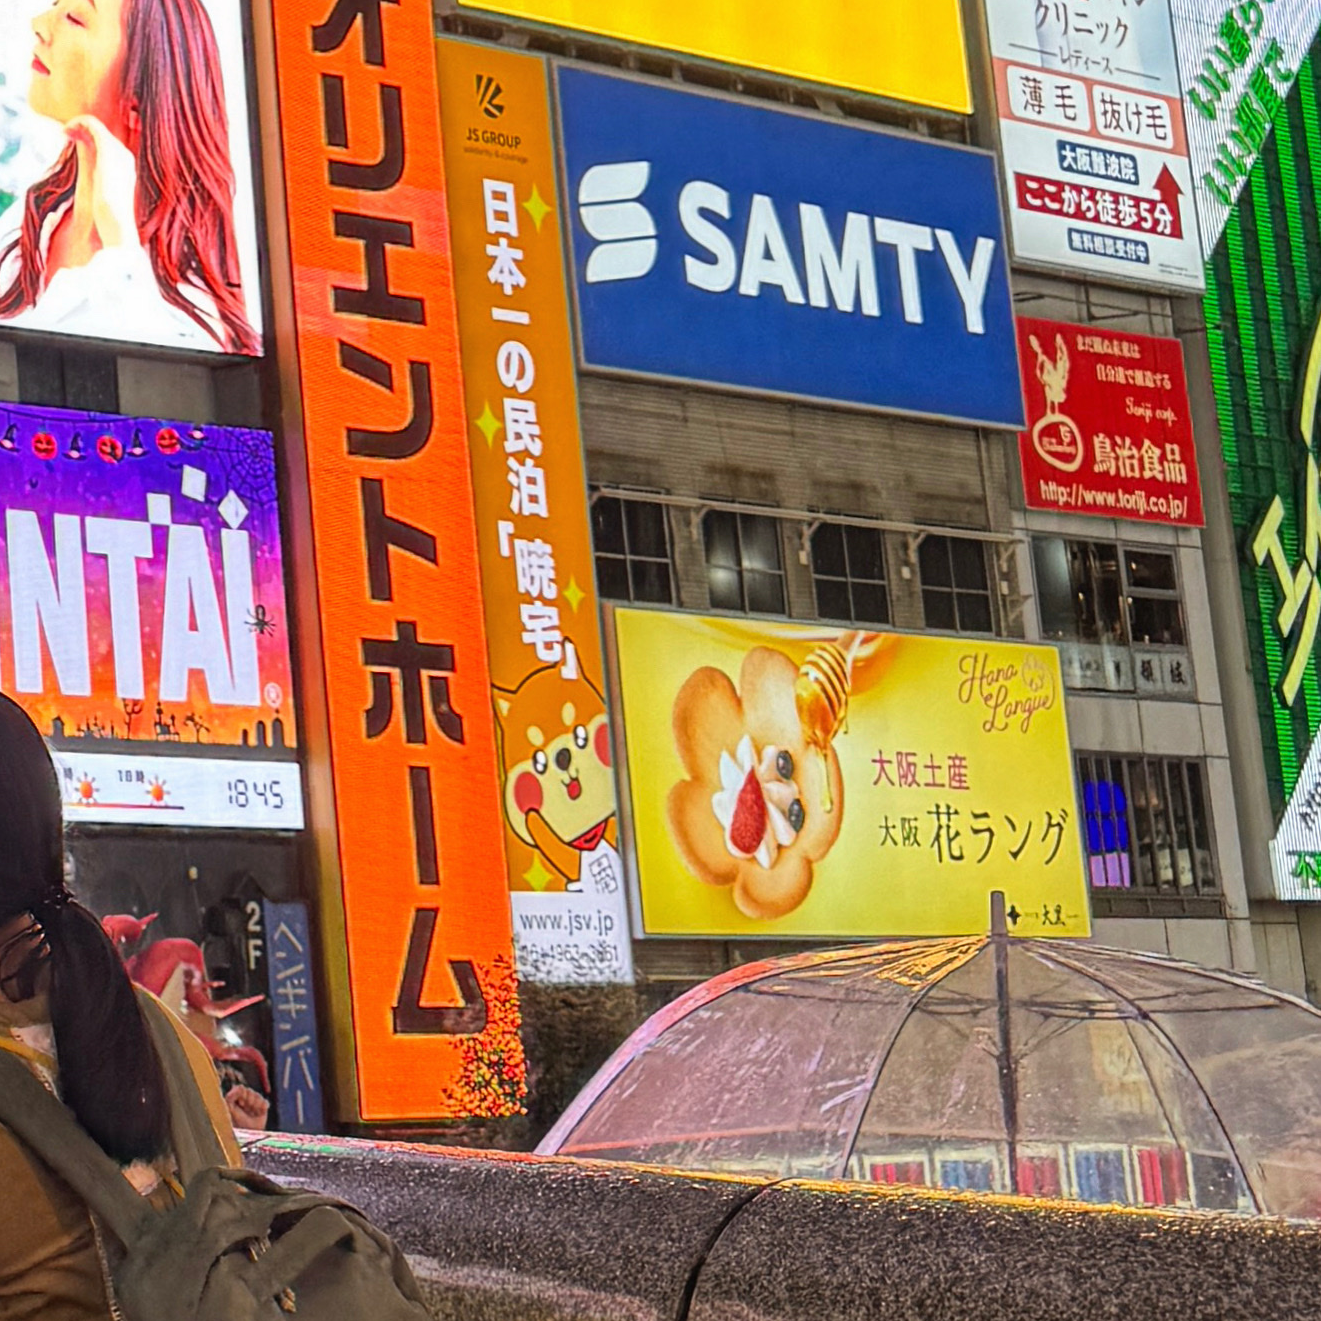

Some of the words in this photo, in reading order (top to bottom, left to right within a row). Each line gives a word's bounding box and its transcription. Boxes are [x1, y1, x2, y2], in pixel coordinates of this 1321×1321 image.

[1059, 50, 1114, 75] レディース
[1101, 92, 1168, 142] 抜け毛
[1061, 148, 1136, 182] 大阪難波院
[1024, 179, 1173, 235] ここから徒歩5分
[677, 180, 995, 335] SAMTY
[1093, 432, 1188, 484] 鳥治食品
[870, 748, 971, 794] 大阪土産
[519, 908, 614, 937] www.jsv.jp
